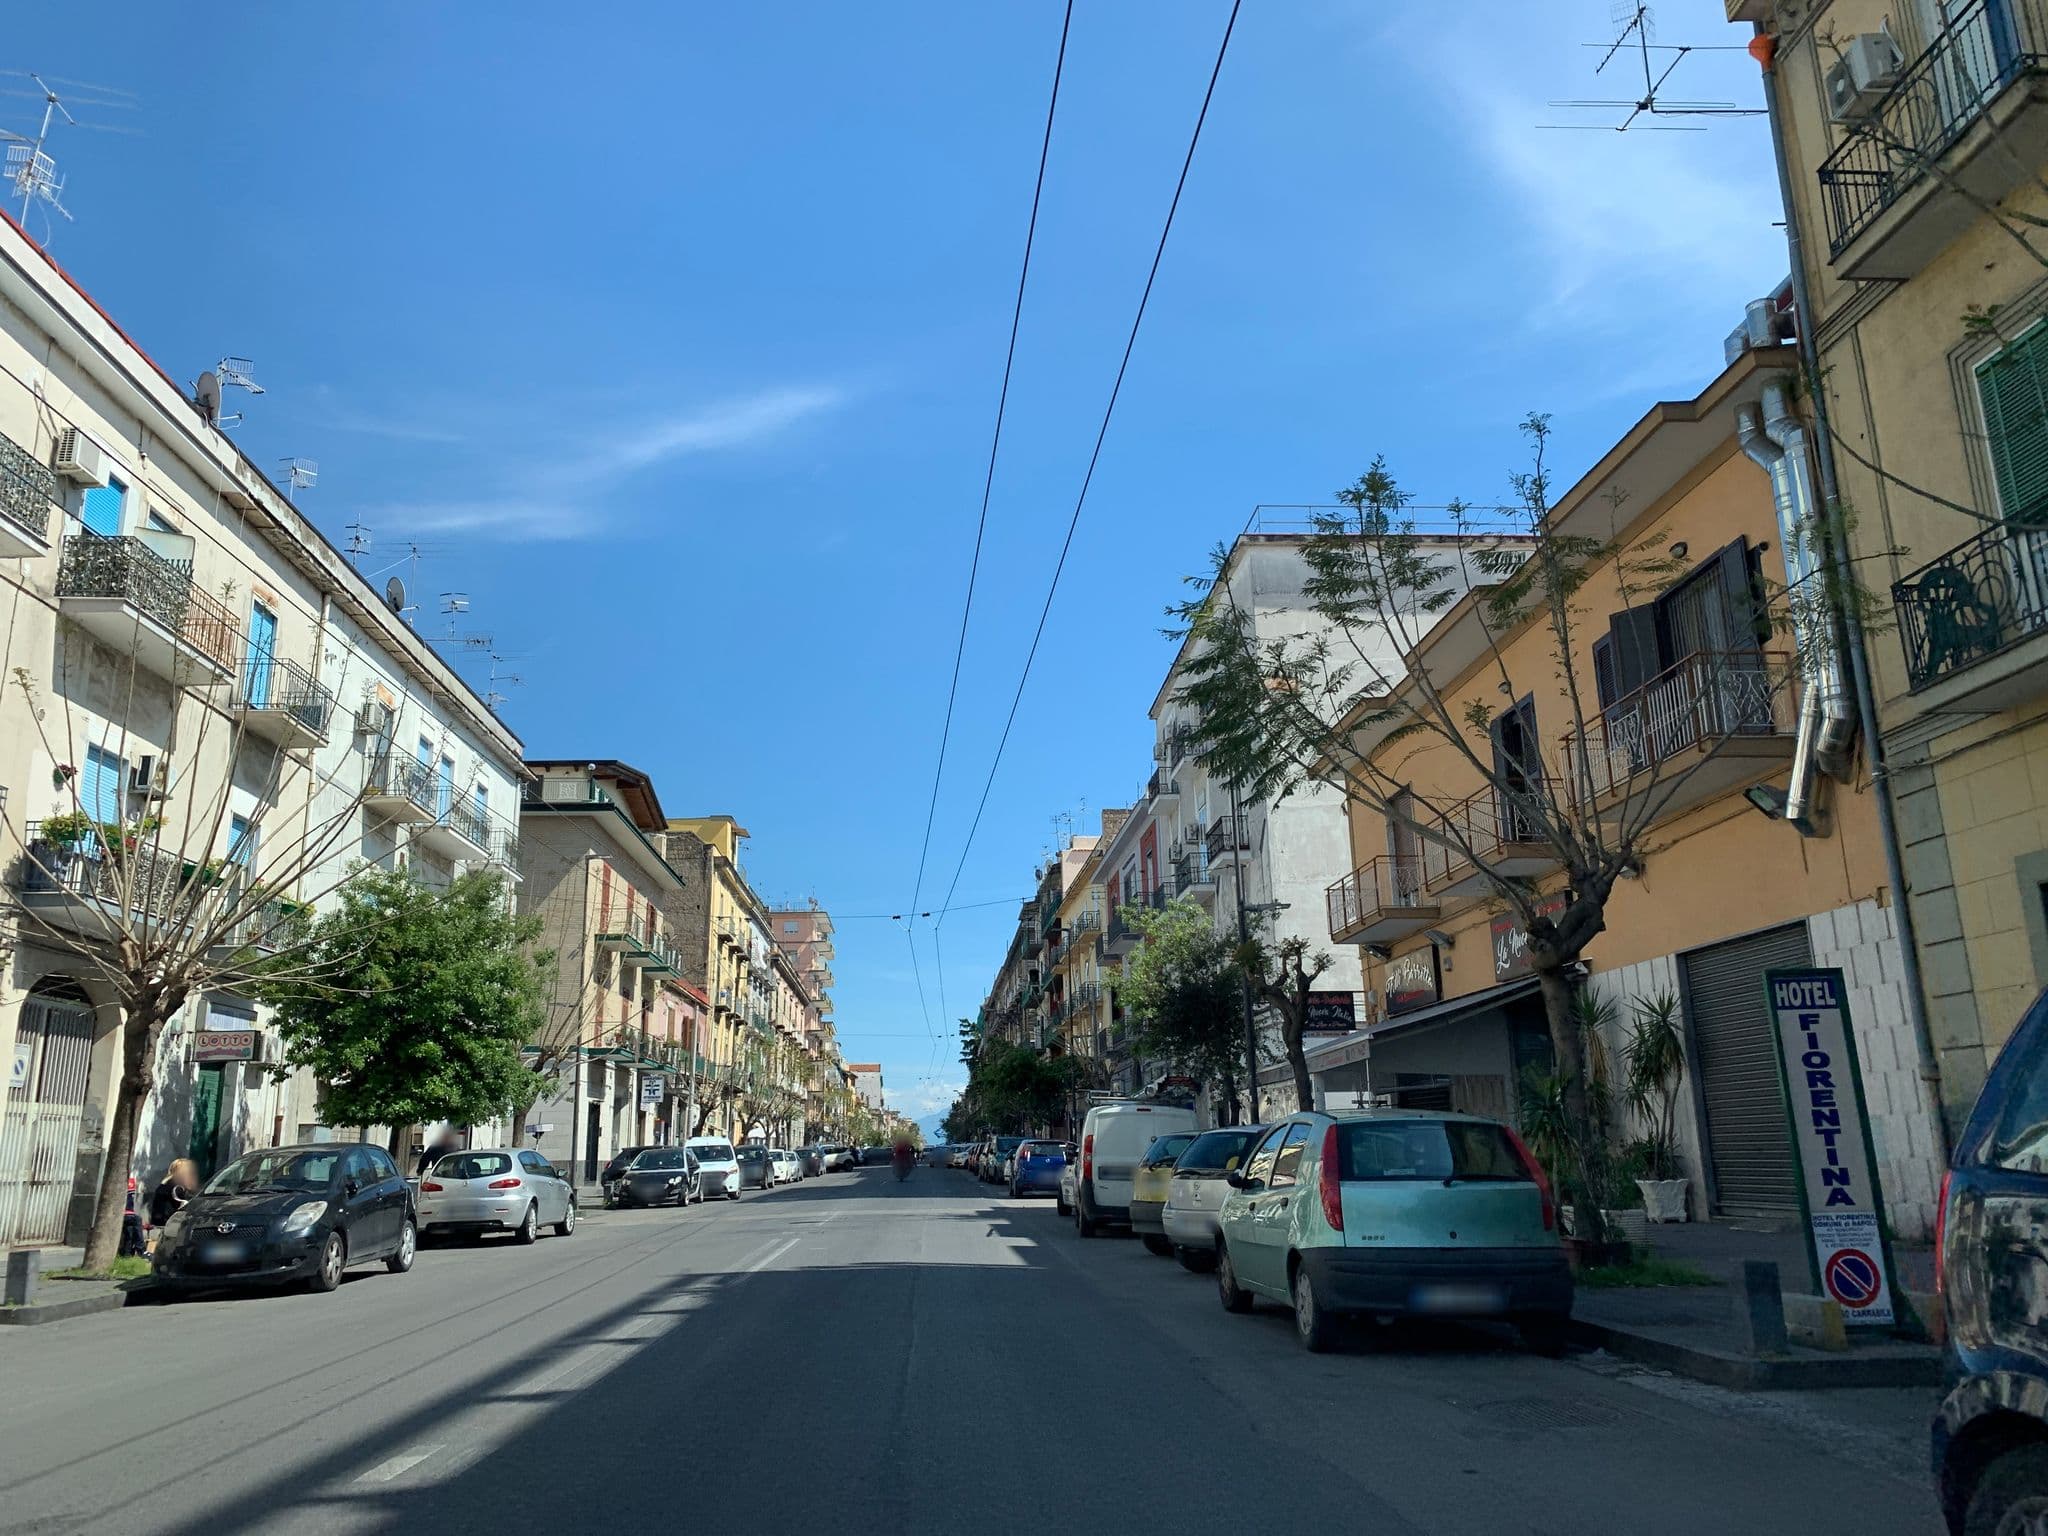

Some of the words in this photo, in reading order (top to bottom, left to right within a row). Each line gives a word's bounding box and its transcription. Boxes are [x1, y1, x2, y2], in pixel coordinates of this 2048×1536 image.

[1774, 981, 1837, 1007] HOTEL
[197, 1033, 253, 1048] LOTTO
[1799, 1013, 1856, 1206] FIORENTINA
